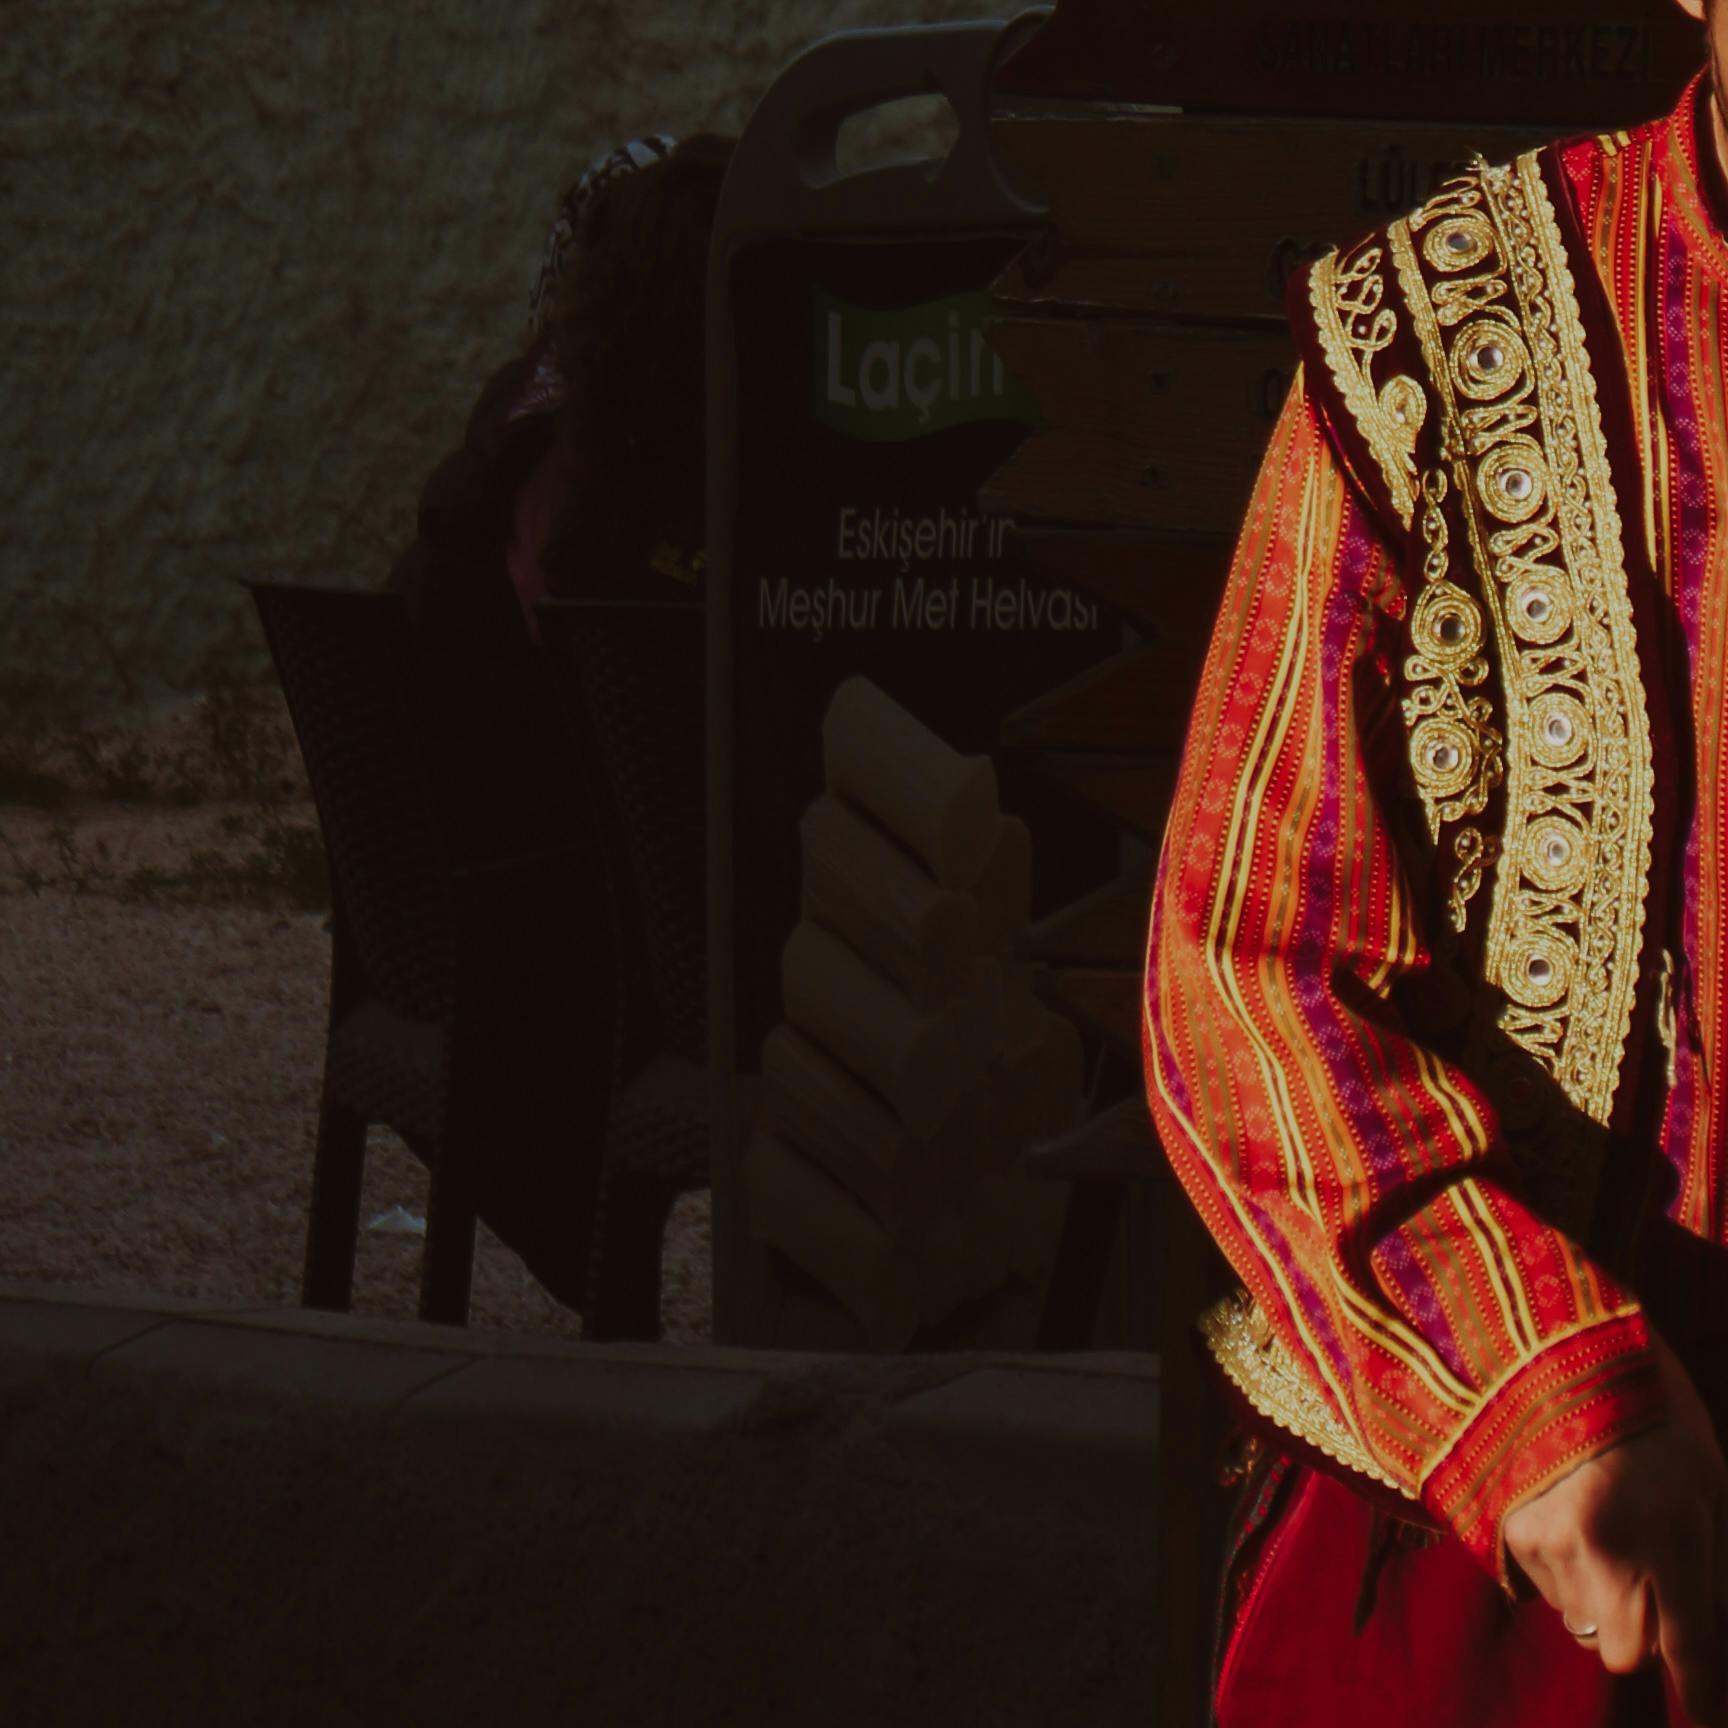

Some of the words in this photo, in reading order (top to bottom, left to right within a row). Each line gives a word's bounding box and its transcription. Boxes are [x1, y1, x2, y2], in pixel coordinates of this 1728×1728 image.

[828, 309, 1005, 424] Laçin
[758, 576, 882, 643] Meşhur
[893, 576, 961, 630] Met
